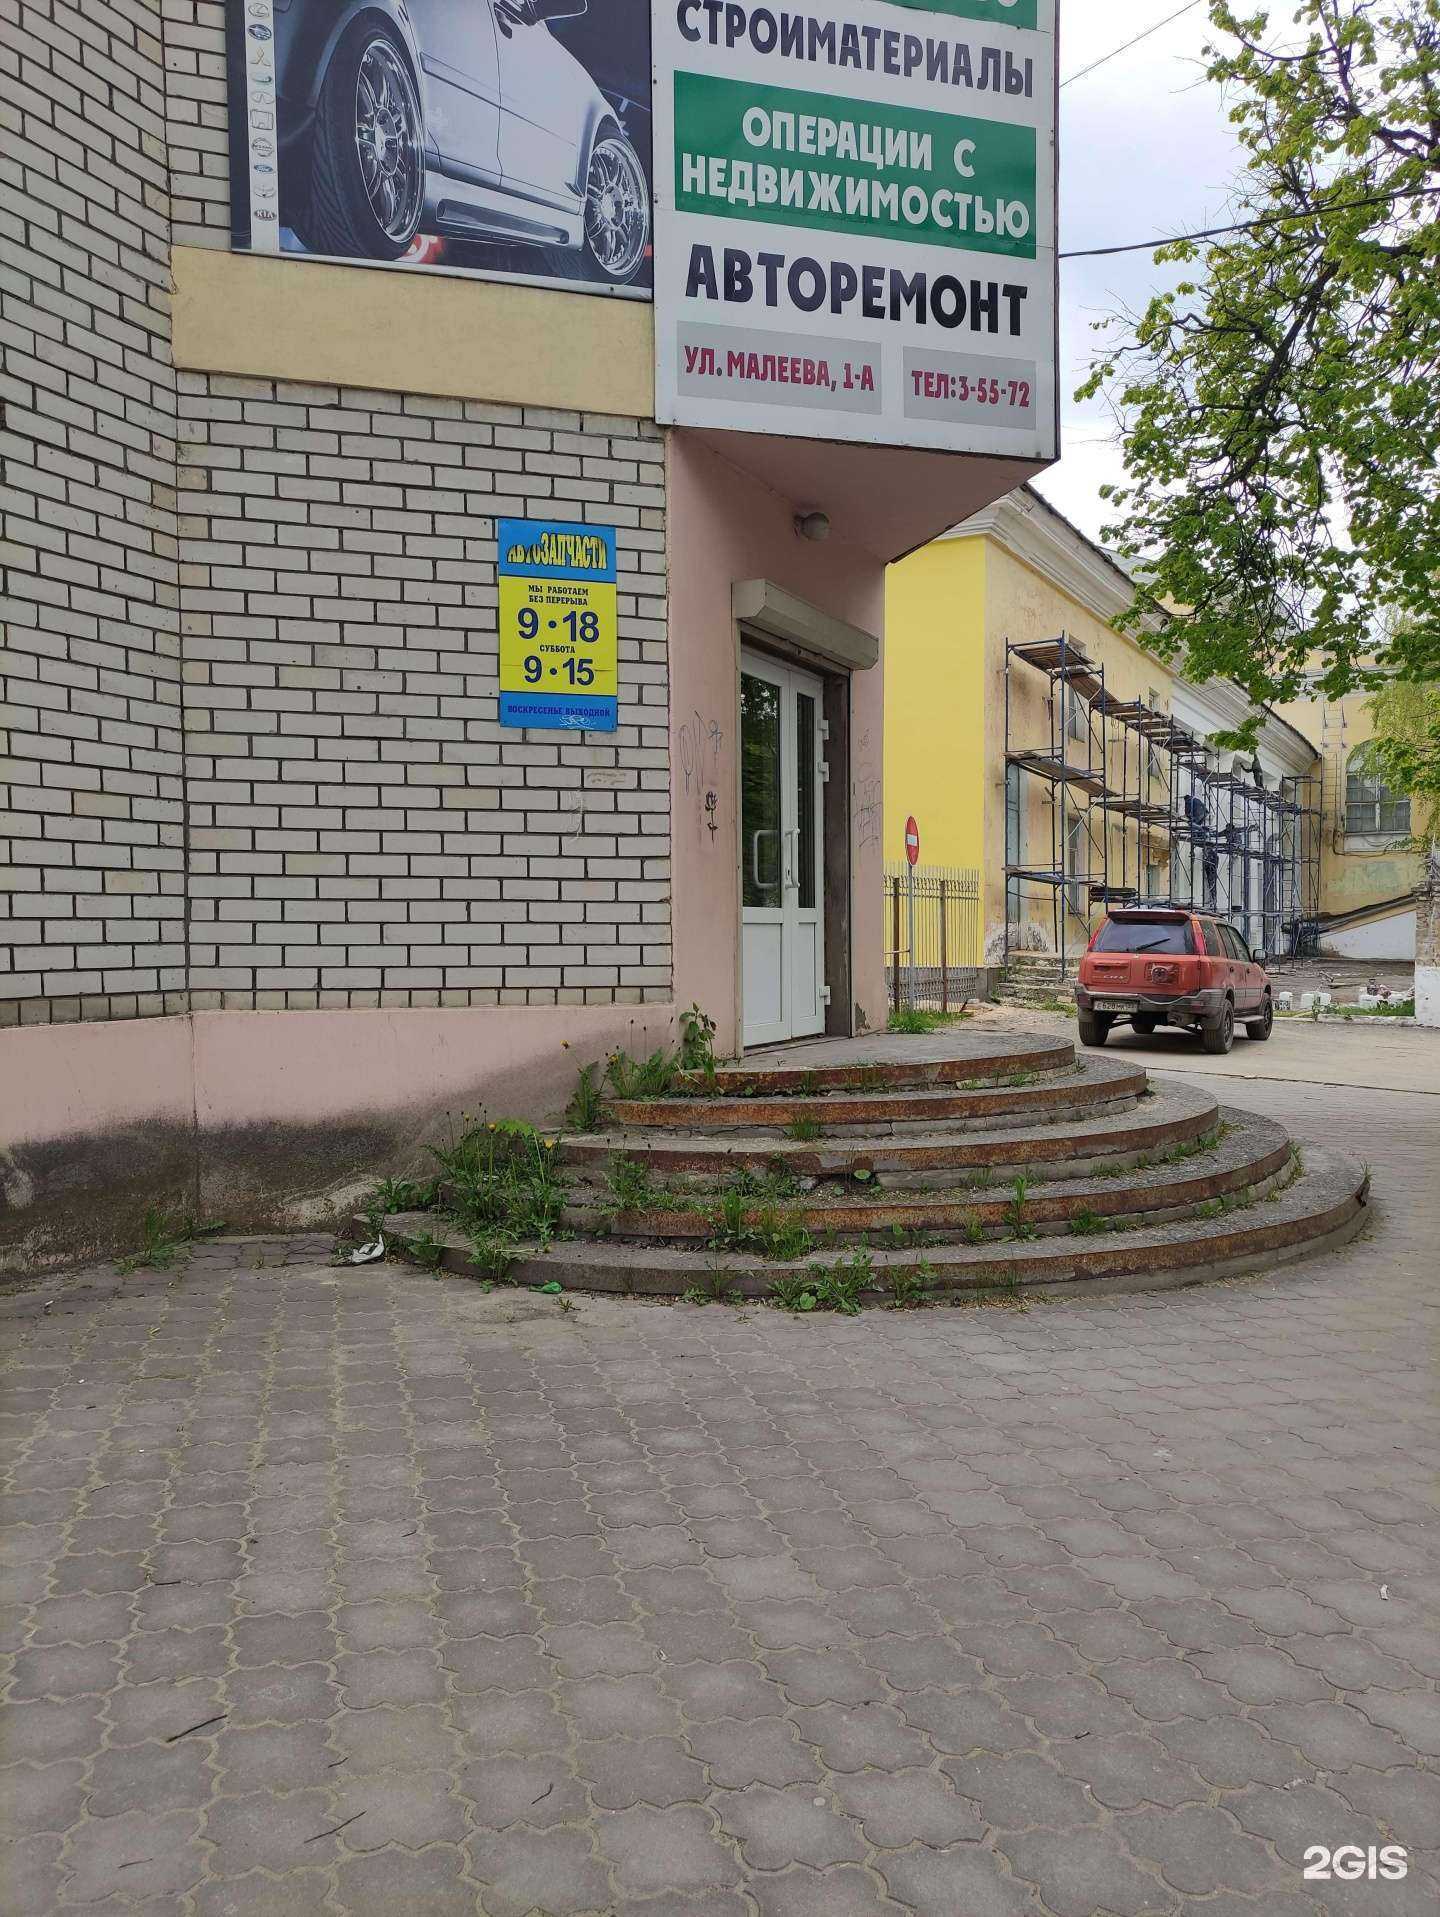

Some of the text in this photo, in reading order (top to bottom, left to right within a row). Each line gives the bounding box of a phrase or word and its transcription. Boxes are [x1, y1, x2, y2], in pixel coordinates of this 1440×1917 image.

[742, 106, 976, 178] ОПЕРАЦИИ С
[682, 152, 1030, 238] НЕДВИЖИМОСТЬЮ
[685, 243, 1028, 337] АВТОРЕМОНТ
[684, 345, 875, 392] УЛ. МАЛЕЕВА, 1-А
[528, 585, 589, 596] МЫ РАБОТАЕМ
[529, 595, 588, 606] БЕЗ ПЕРЕРЫВА
[540, 645, 576, 654] СУББОТА
[508, 705, 562, 715] ВОСКРЕСЕНЬЕ
